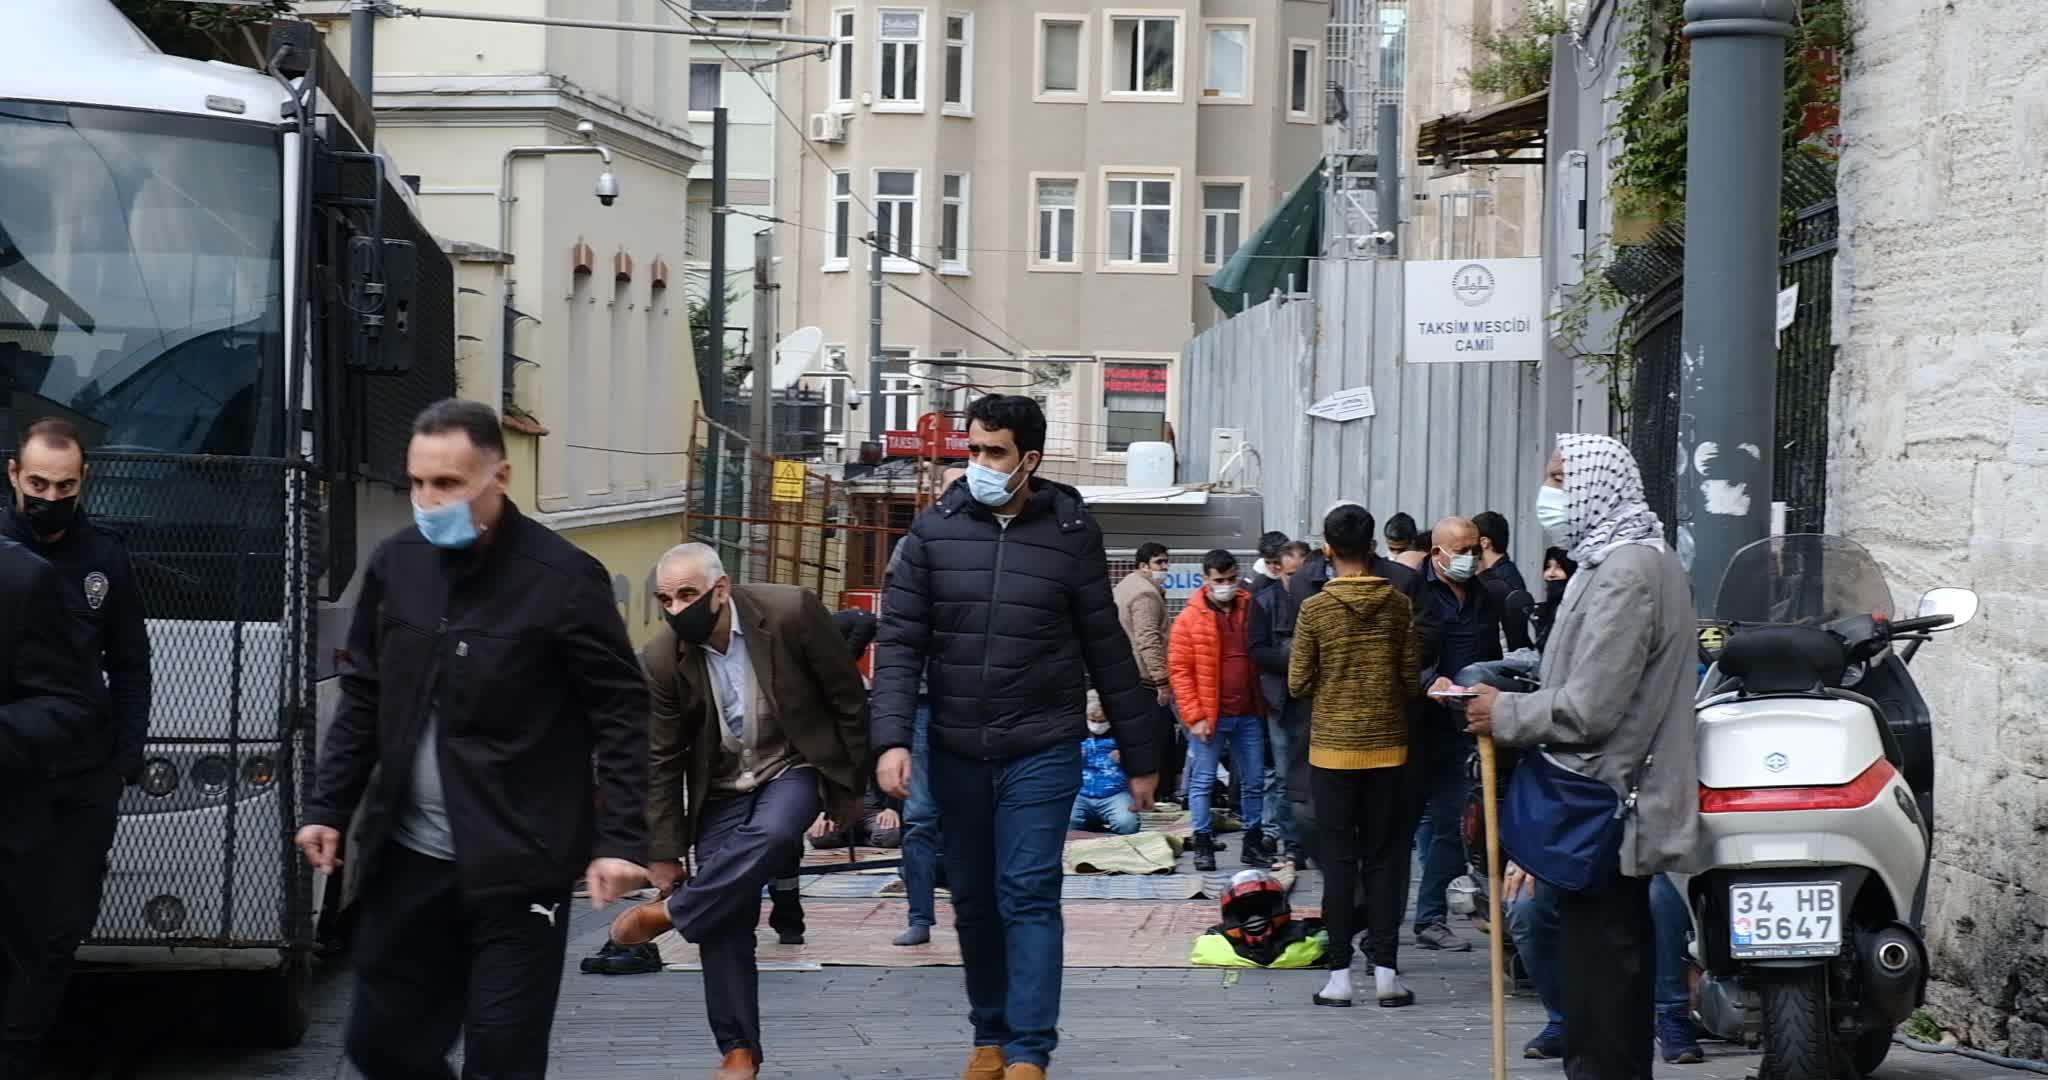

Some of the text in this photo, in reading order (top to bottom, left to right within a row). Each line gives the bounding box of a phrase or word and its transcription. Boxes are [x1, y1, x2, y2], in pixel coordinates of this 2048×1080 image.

[1418, 316, 1531, 335] TAKSİM MESCİDİ
[1455, 335, 1494, 352] CAMİİ
[1162, 569, 1204, 589] OLİS
[1737, 889, 1834, 914] 34 HB
[1755, 915, 1833, 941] 5647
